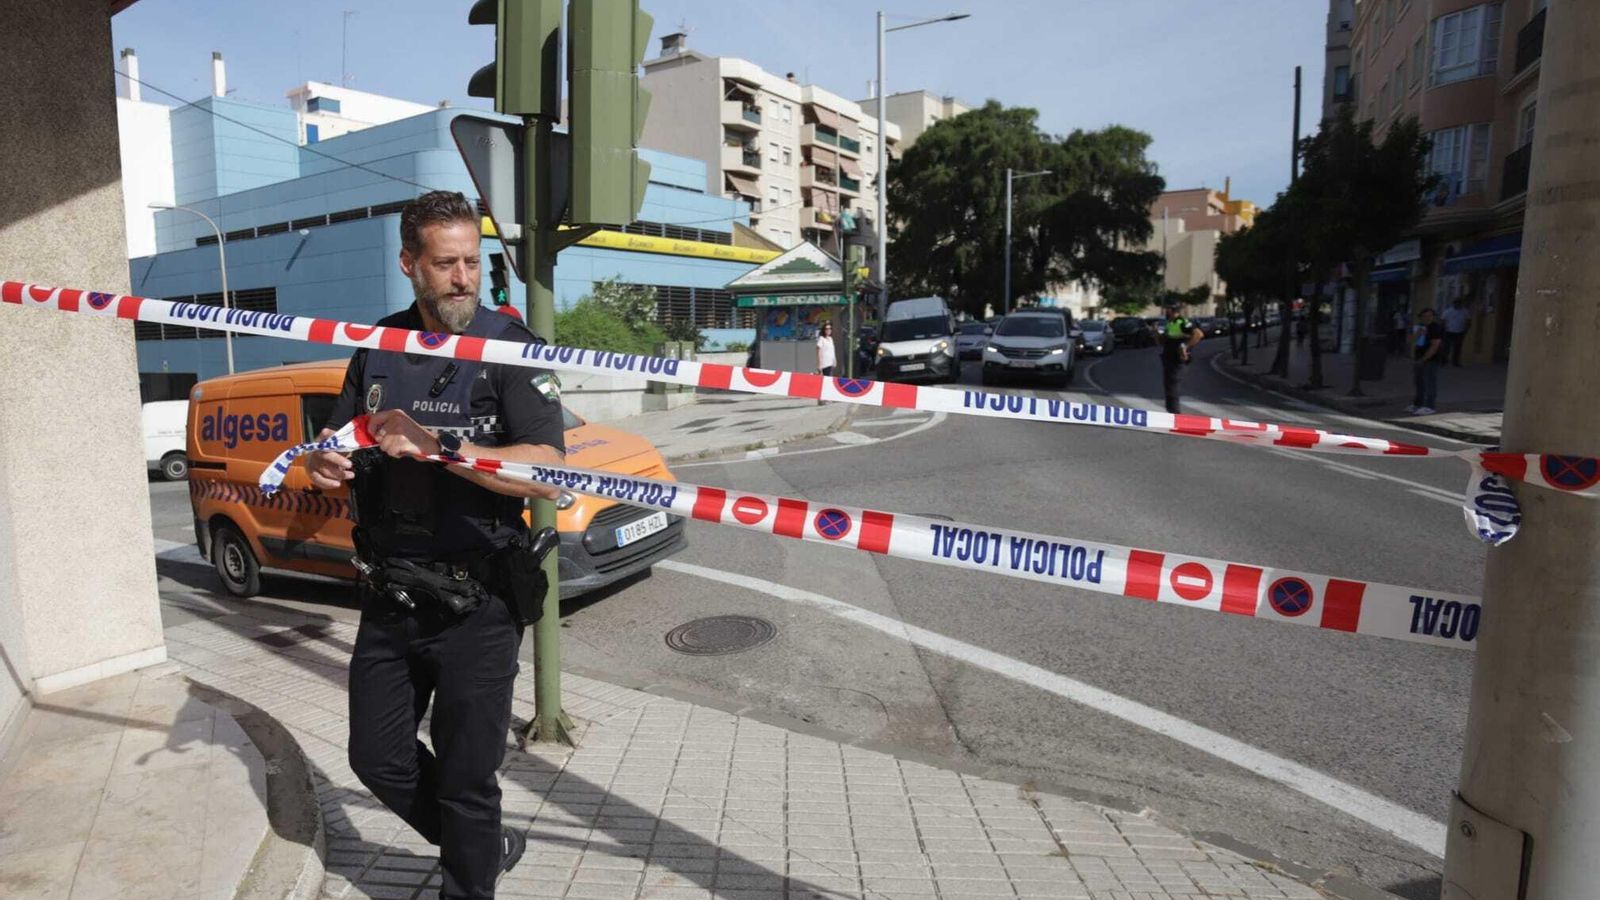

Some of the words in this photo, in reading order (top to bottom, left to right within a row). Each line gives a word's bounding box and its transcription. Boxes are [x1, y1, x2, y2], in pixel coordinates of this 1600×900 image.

[752, 297, 775, 306] EL
[412, 400, 460, 414] POLICIA
[201, 406, 289, 449] algesa
[596, 476, 678, 508] POLICIA
[624, 521, 647, 541] 0185
[930, 524, 1003, 567] LOCAL
[1010, 537, 1104, 585] POLICIA
[1409, 595, 1481, 642] OCAL
